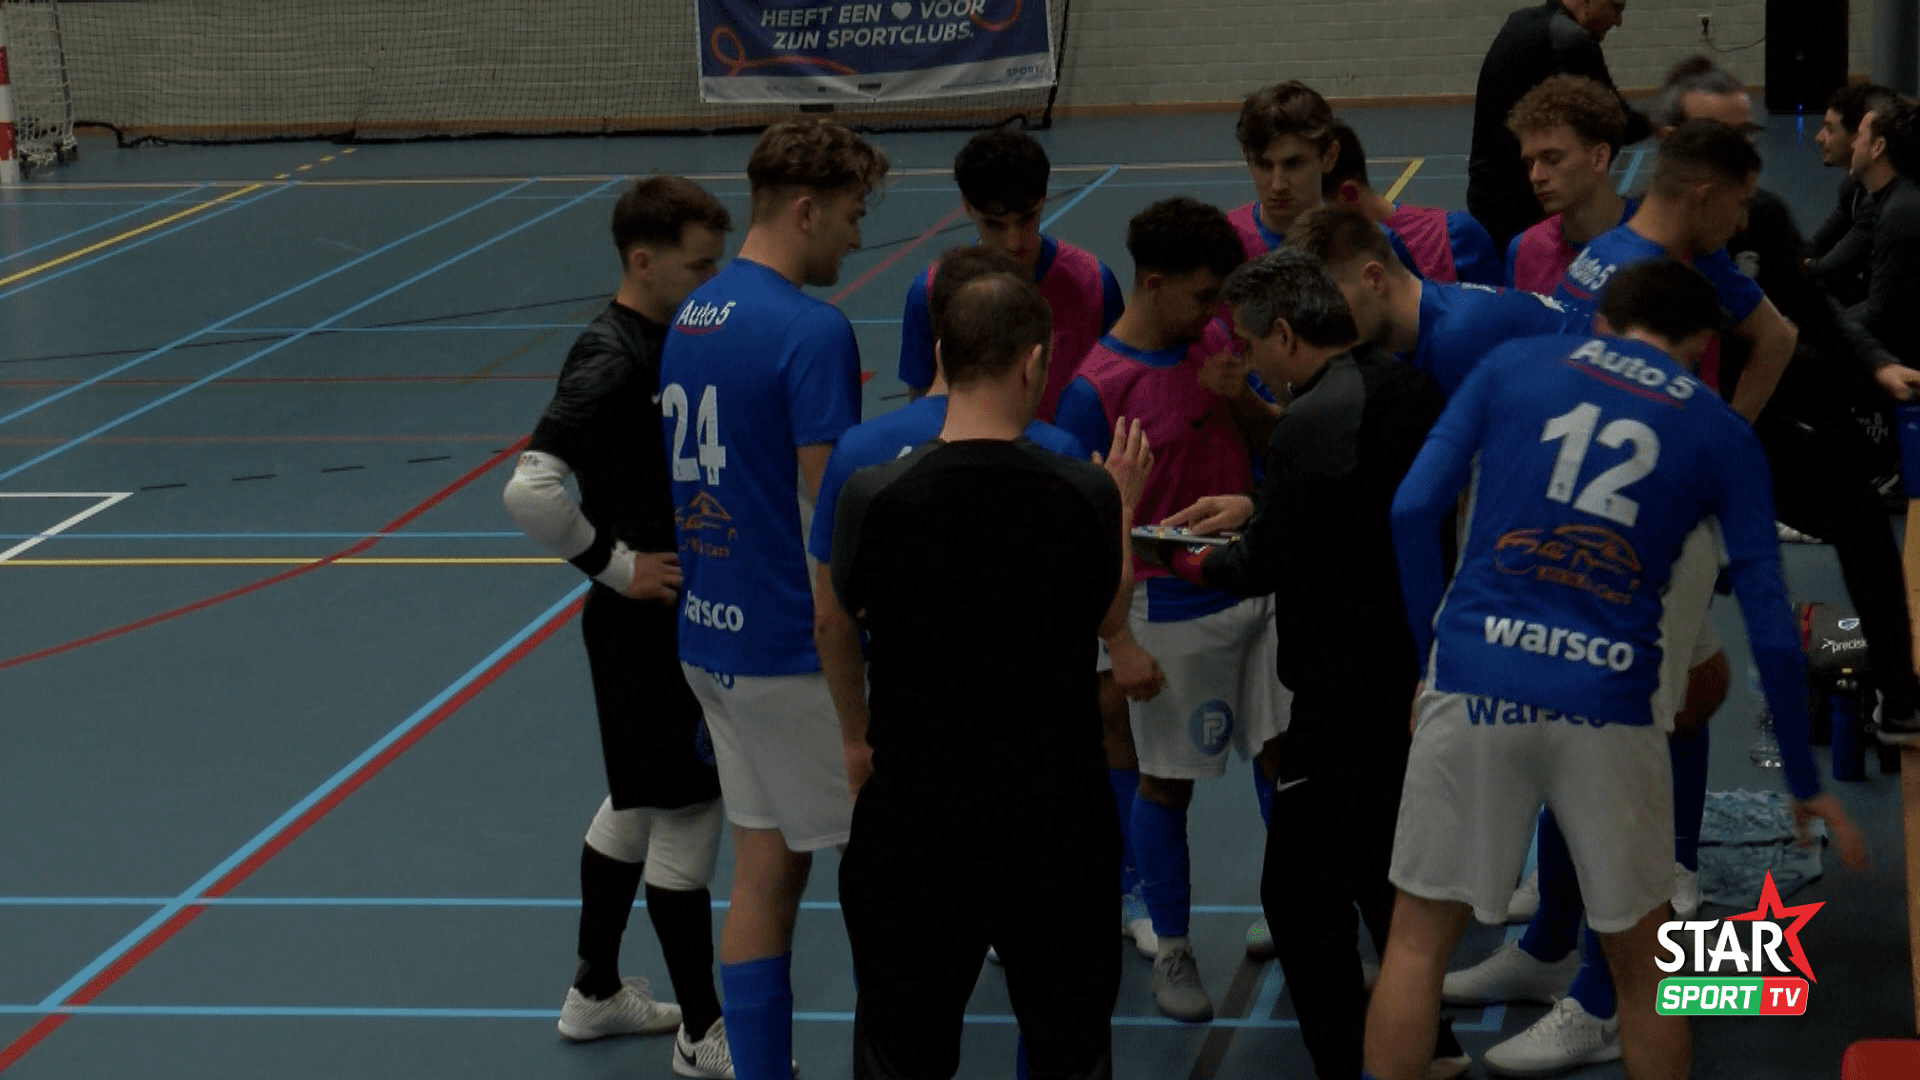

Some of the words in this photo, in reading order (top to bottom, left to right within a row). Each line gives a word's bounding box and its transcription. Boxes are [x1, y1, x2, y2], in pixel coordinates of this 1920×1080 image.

[760, 7, 833, 27] HEEFT
[838, 3, 882, 24] EEN
[920, 0, 985, 19] VOOR
[826, 20, 975, 48] SPORTCLUBS.
[661, 382, 727, 486] 24
[1539, 401, 1662, 528] 12
[684, 590, 744, 632] arsco
[1484, 614, 1635, 673] warsco
